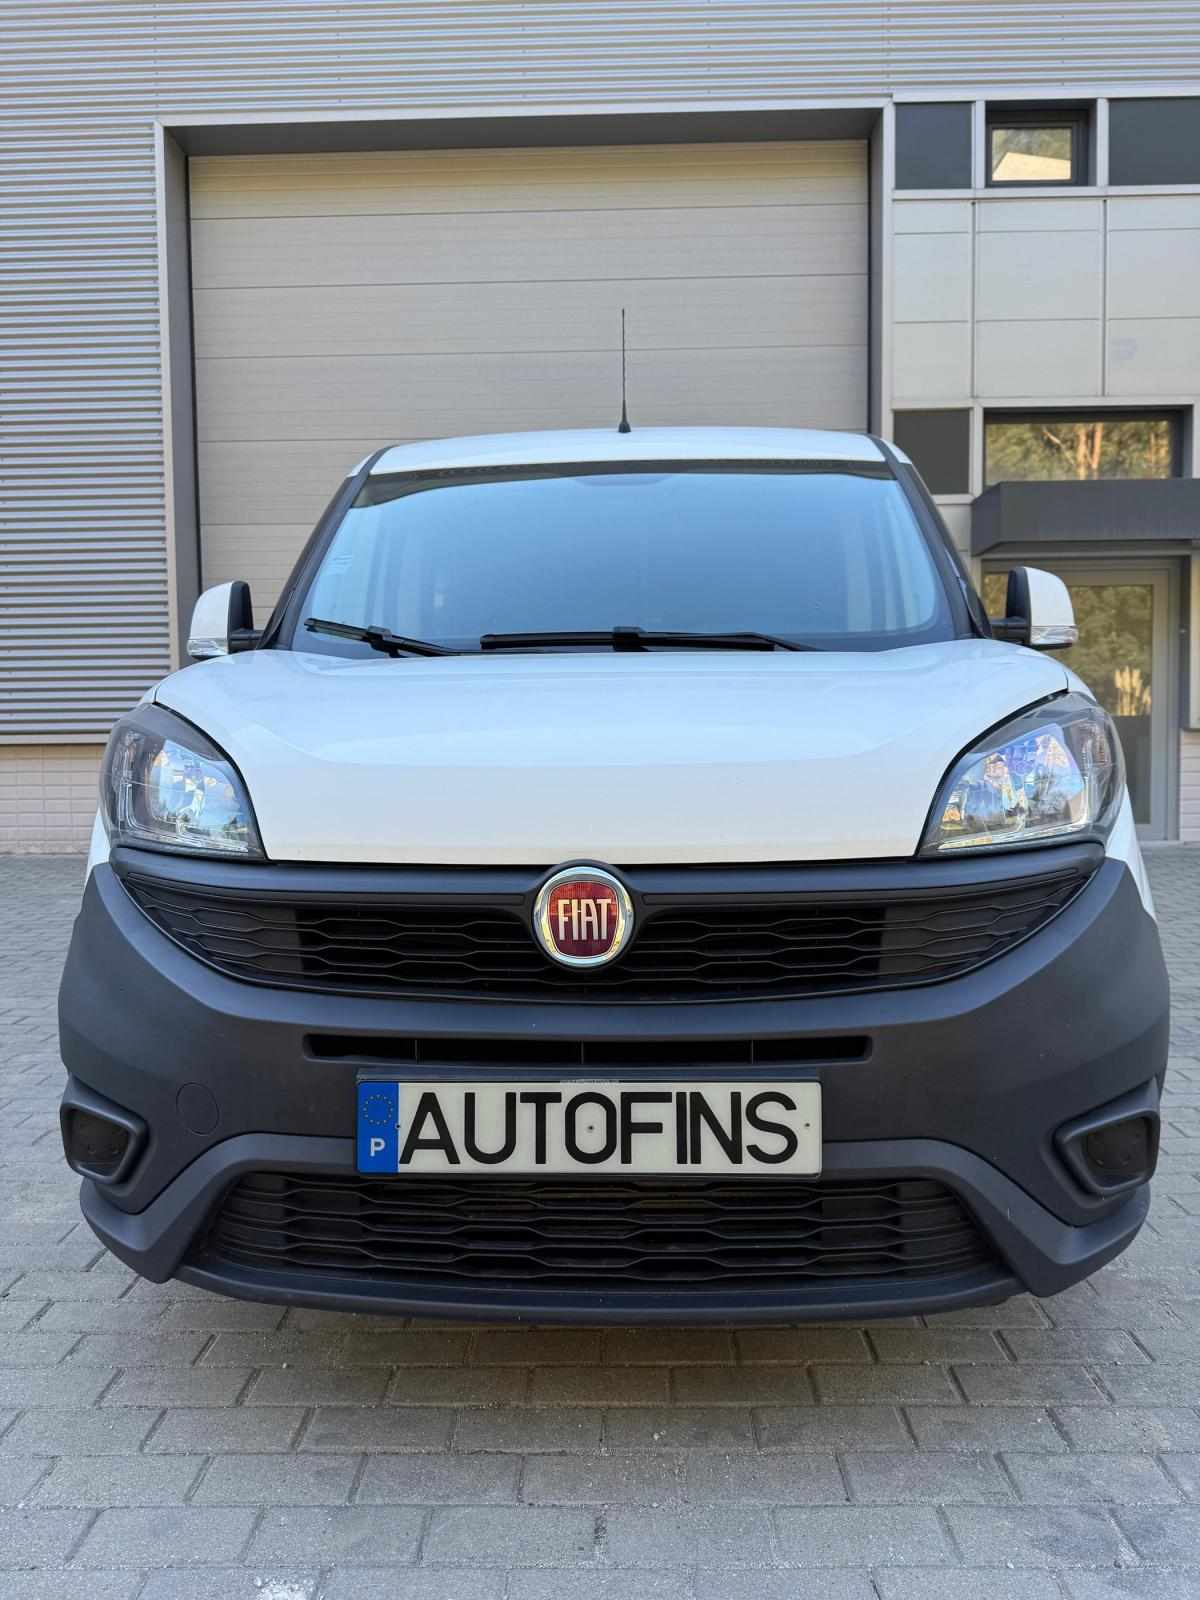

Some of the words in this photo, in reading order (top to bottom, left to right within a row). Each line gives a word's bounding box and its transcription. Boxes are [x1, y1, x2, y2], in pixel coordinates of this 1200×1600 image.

[558, 898, 612, 941] FIAT
[370, 1137, 386, 1157] P
[399, 1091, 798, 1165] AUTOFINS
